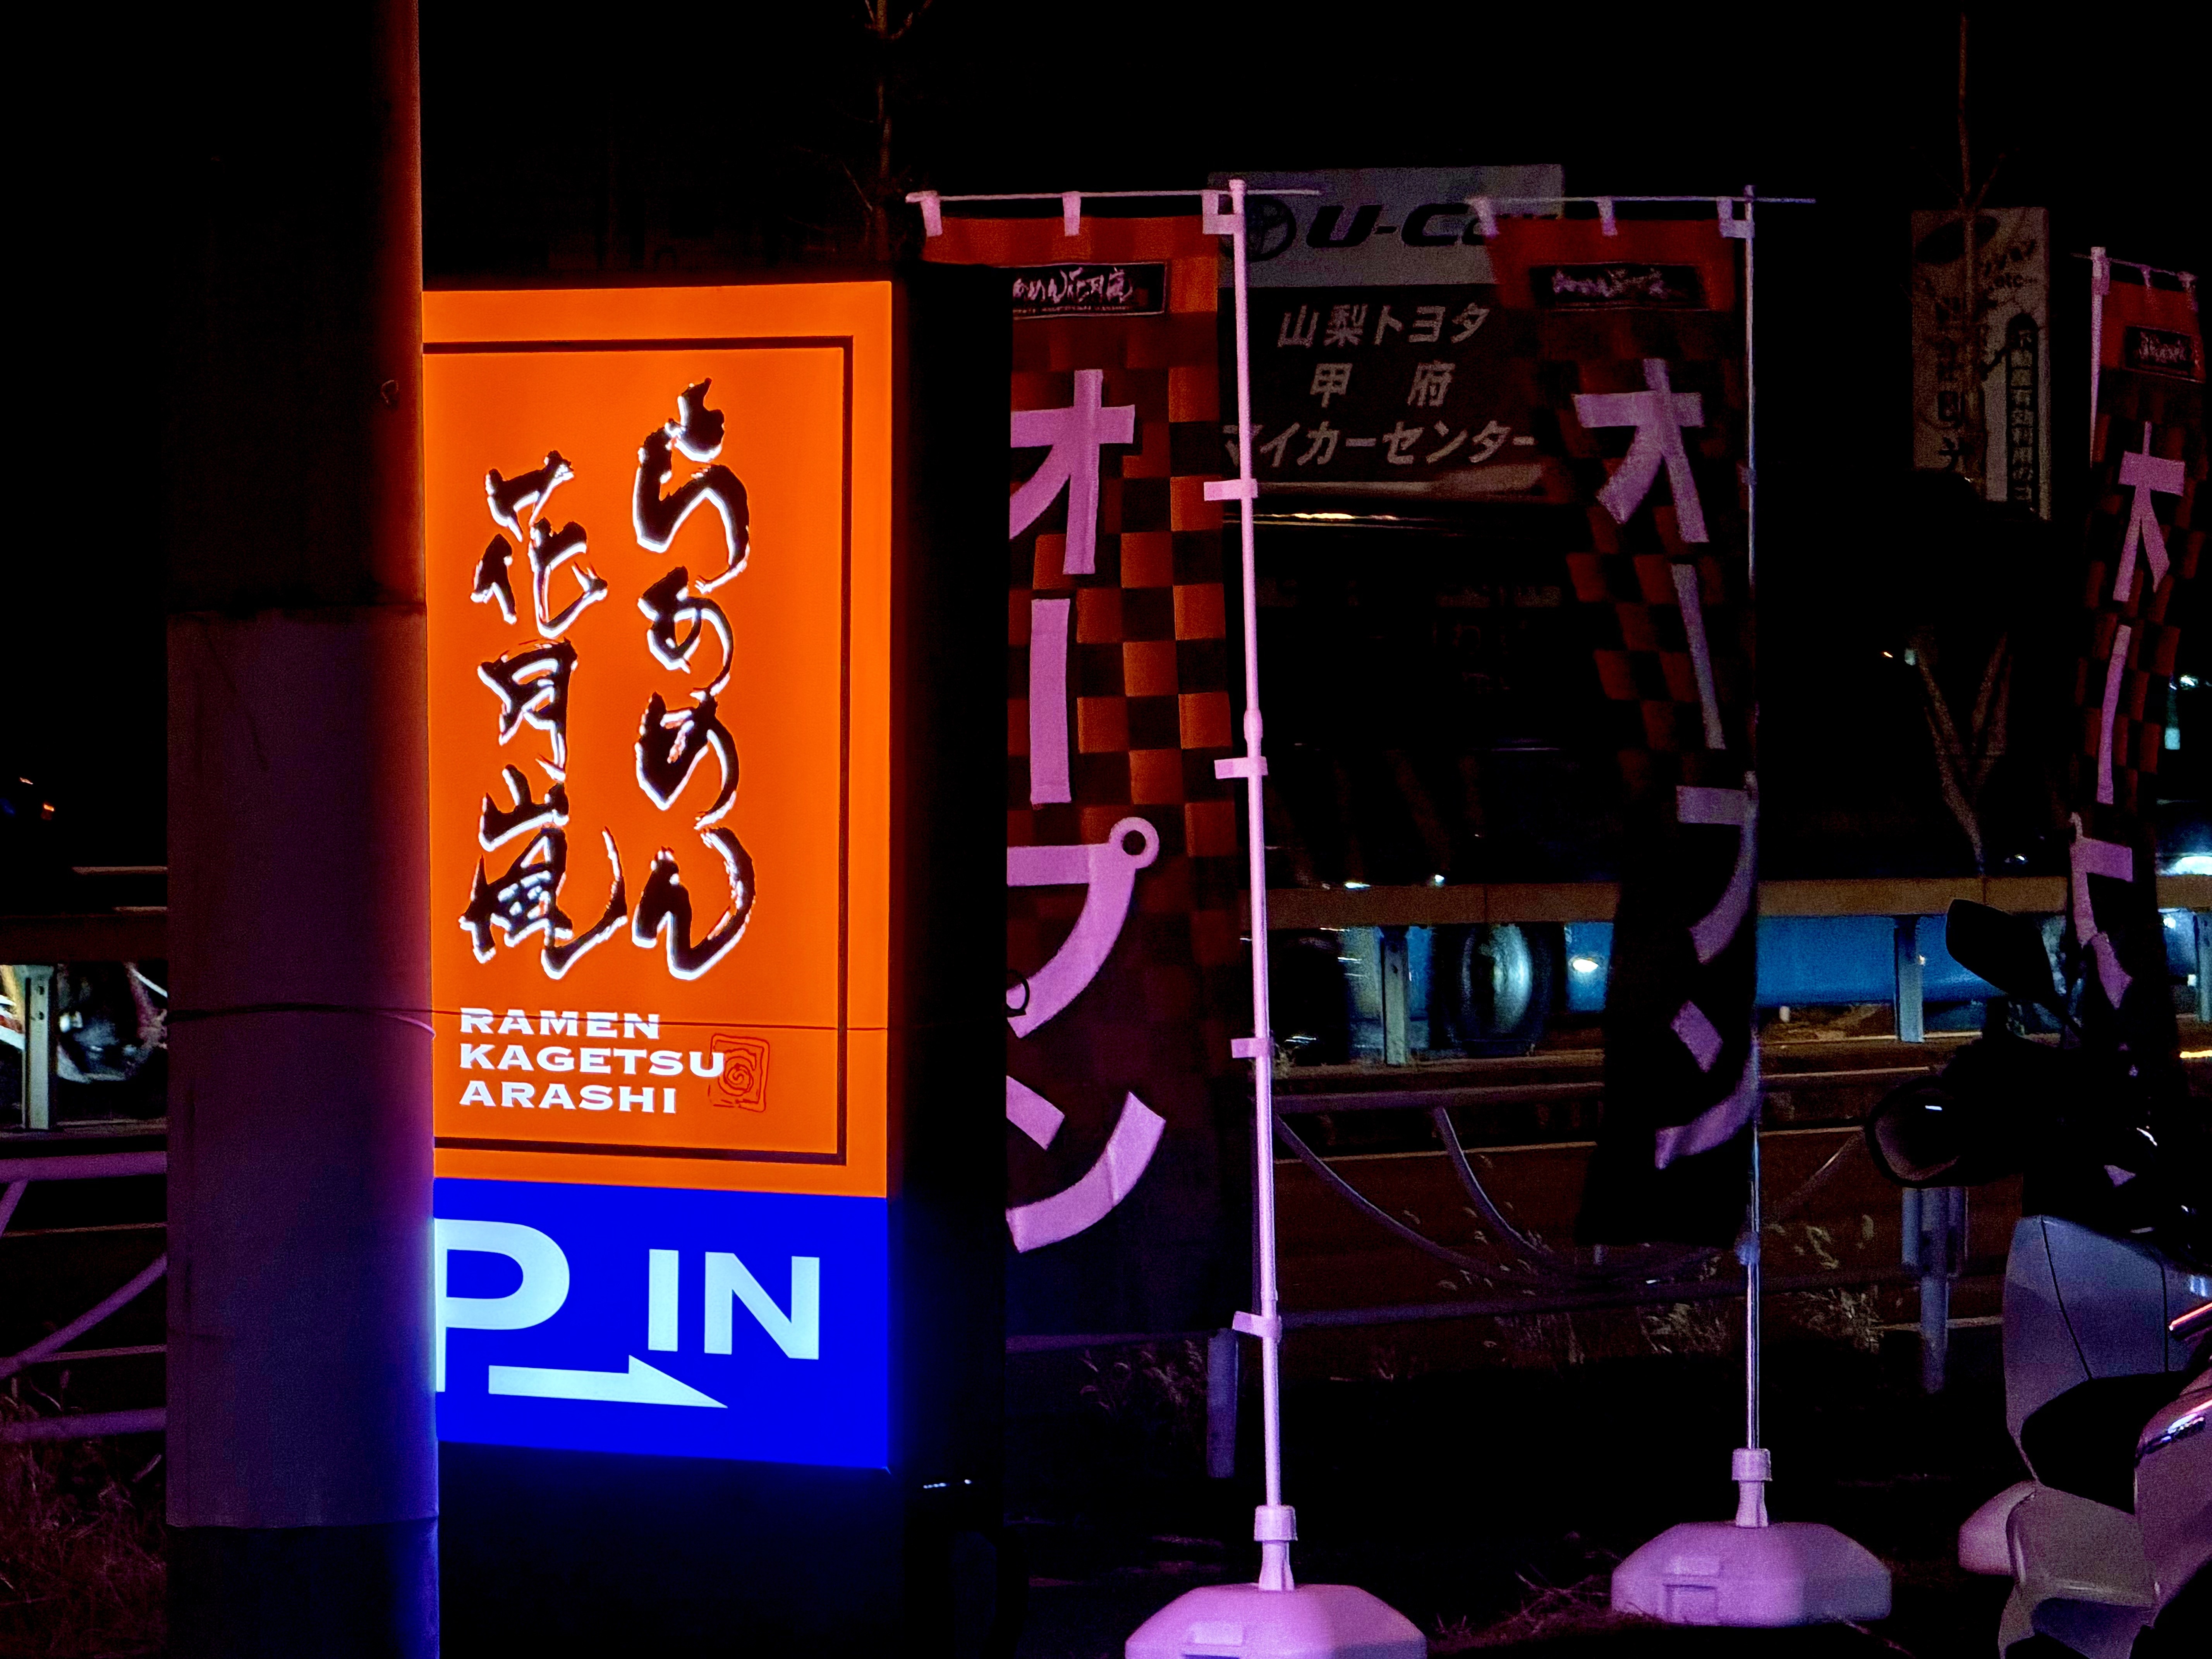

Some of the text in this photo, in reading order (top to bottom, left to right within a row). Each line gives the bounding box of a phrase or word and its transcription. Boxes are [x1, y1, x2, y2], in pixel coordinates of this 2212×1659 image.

[1277, 303, 1491, 348] 山梨トヨタ
[1222, 419, 1536, 468] マイカーセンター
[1006, 369, 1166, 1254] オープン
[460, 1007, 661, 1040] RAMEN
[460, 1042, 725, 1079] KAGETSU
[459, 1080, 677, 1115] ARASHI
[434, 1218, 820, 1393] P IN
